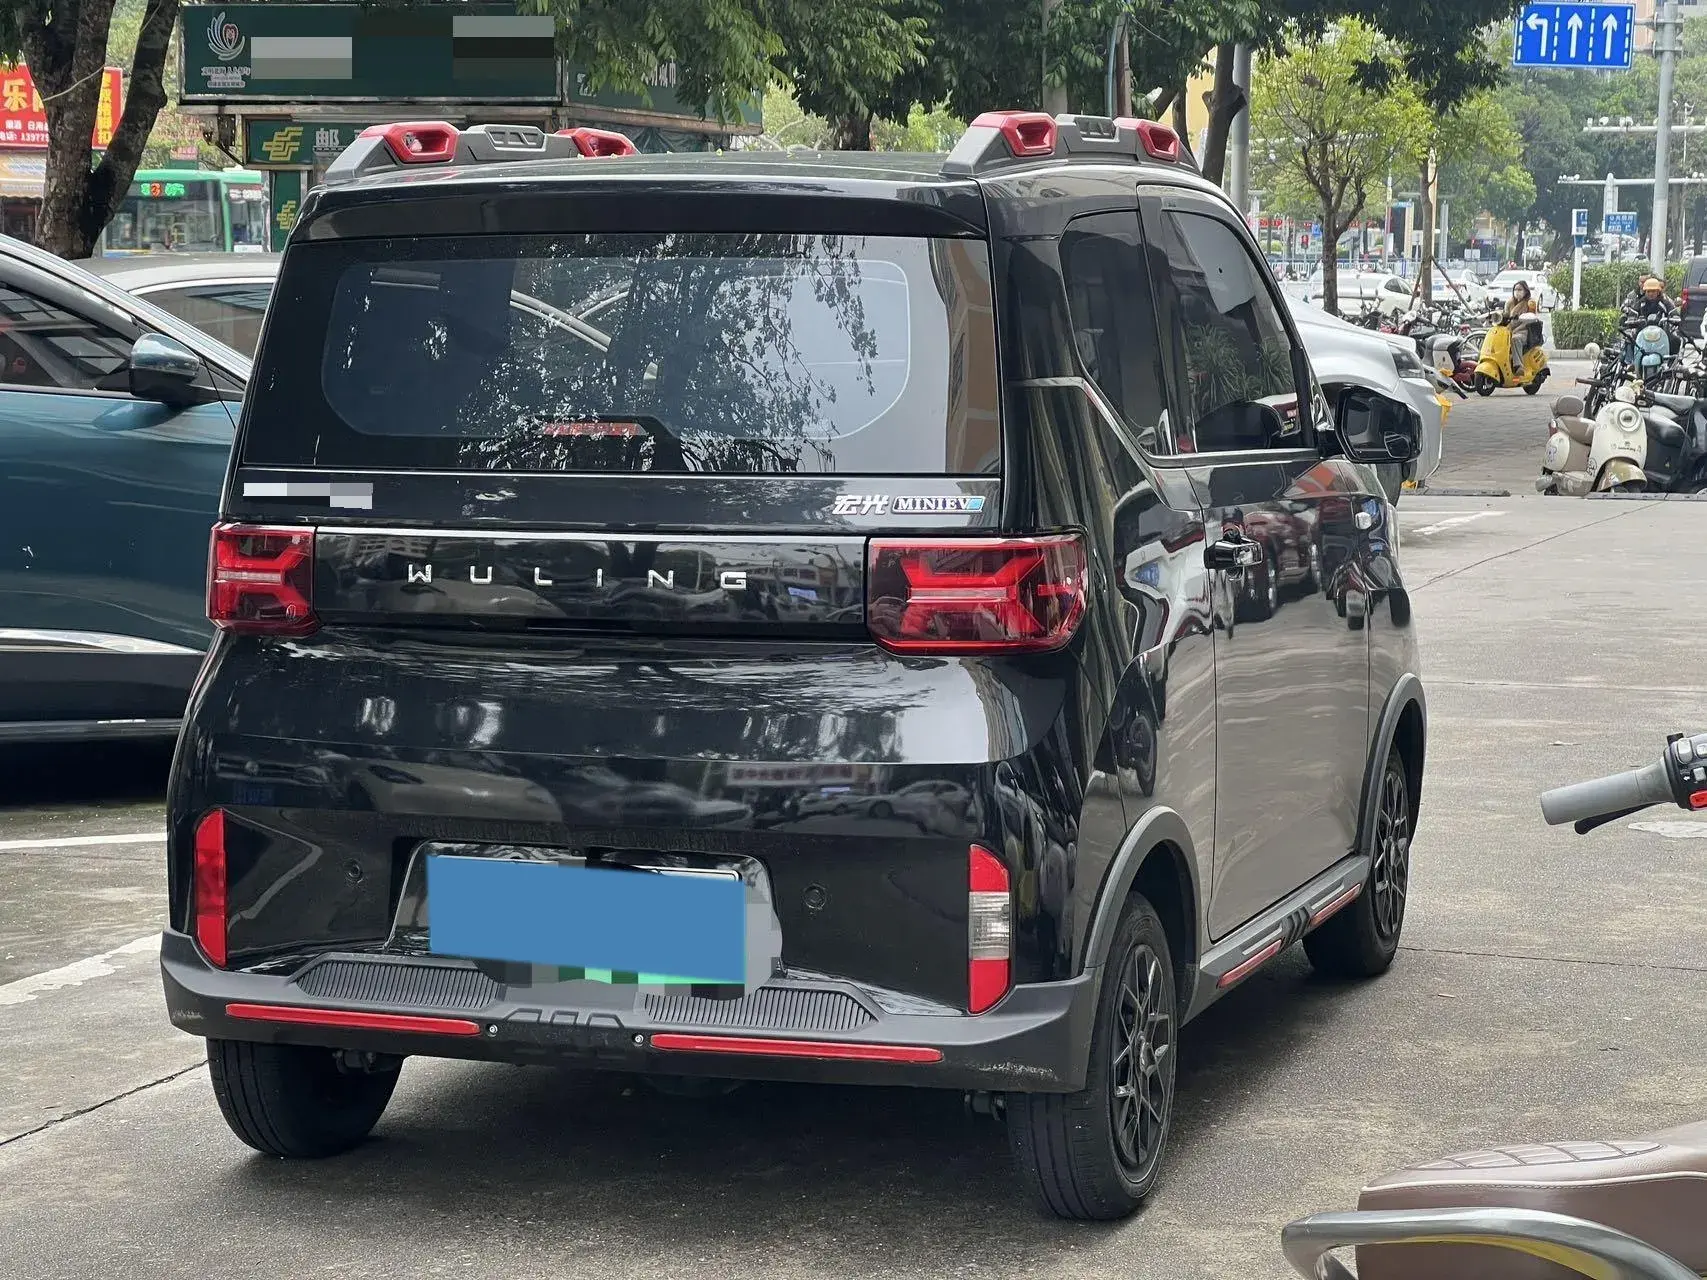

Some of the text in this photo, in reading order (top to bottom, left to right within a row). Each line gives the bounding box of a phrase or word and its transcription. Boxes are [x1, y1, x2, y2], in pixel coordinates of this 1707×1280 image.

[832, 494, 969, 515] 宏光 MINIEV
[408, 563, 748, 591] WULING
